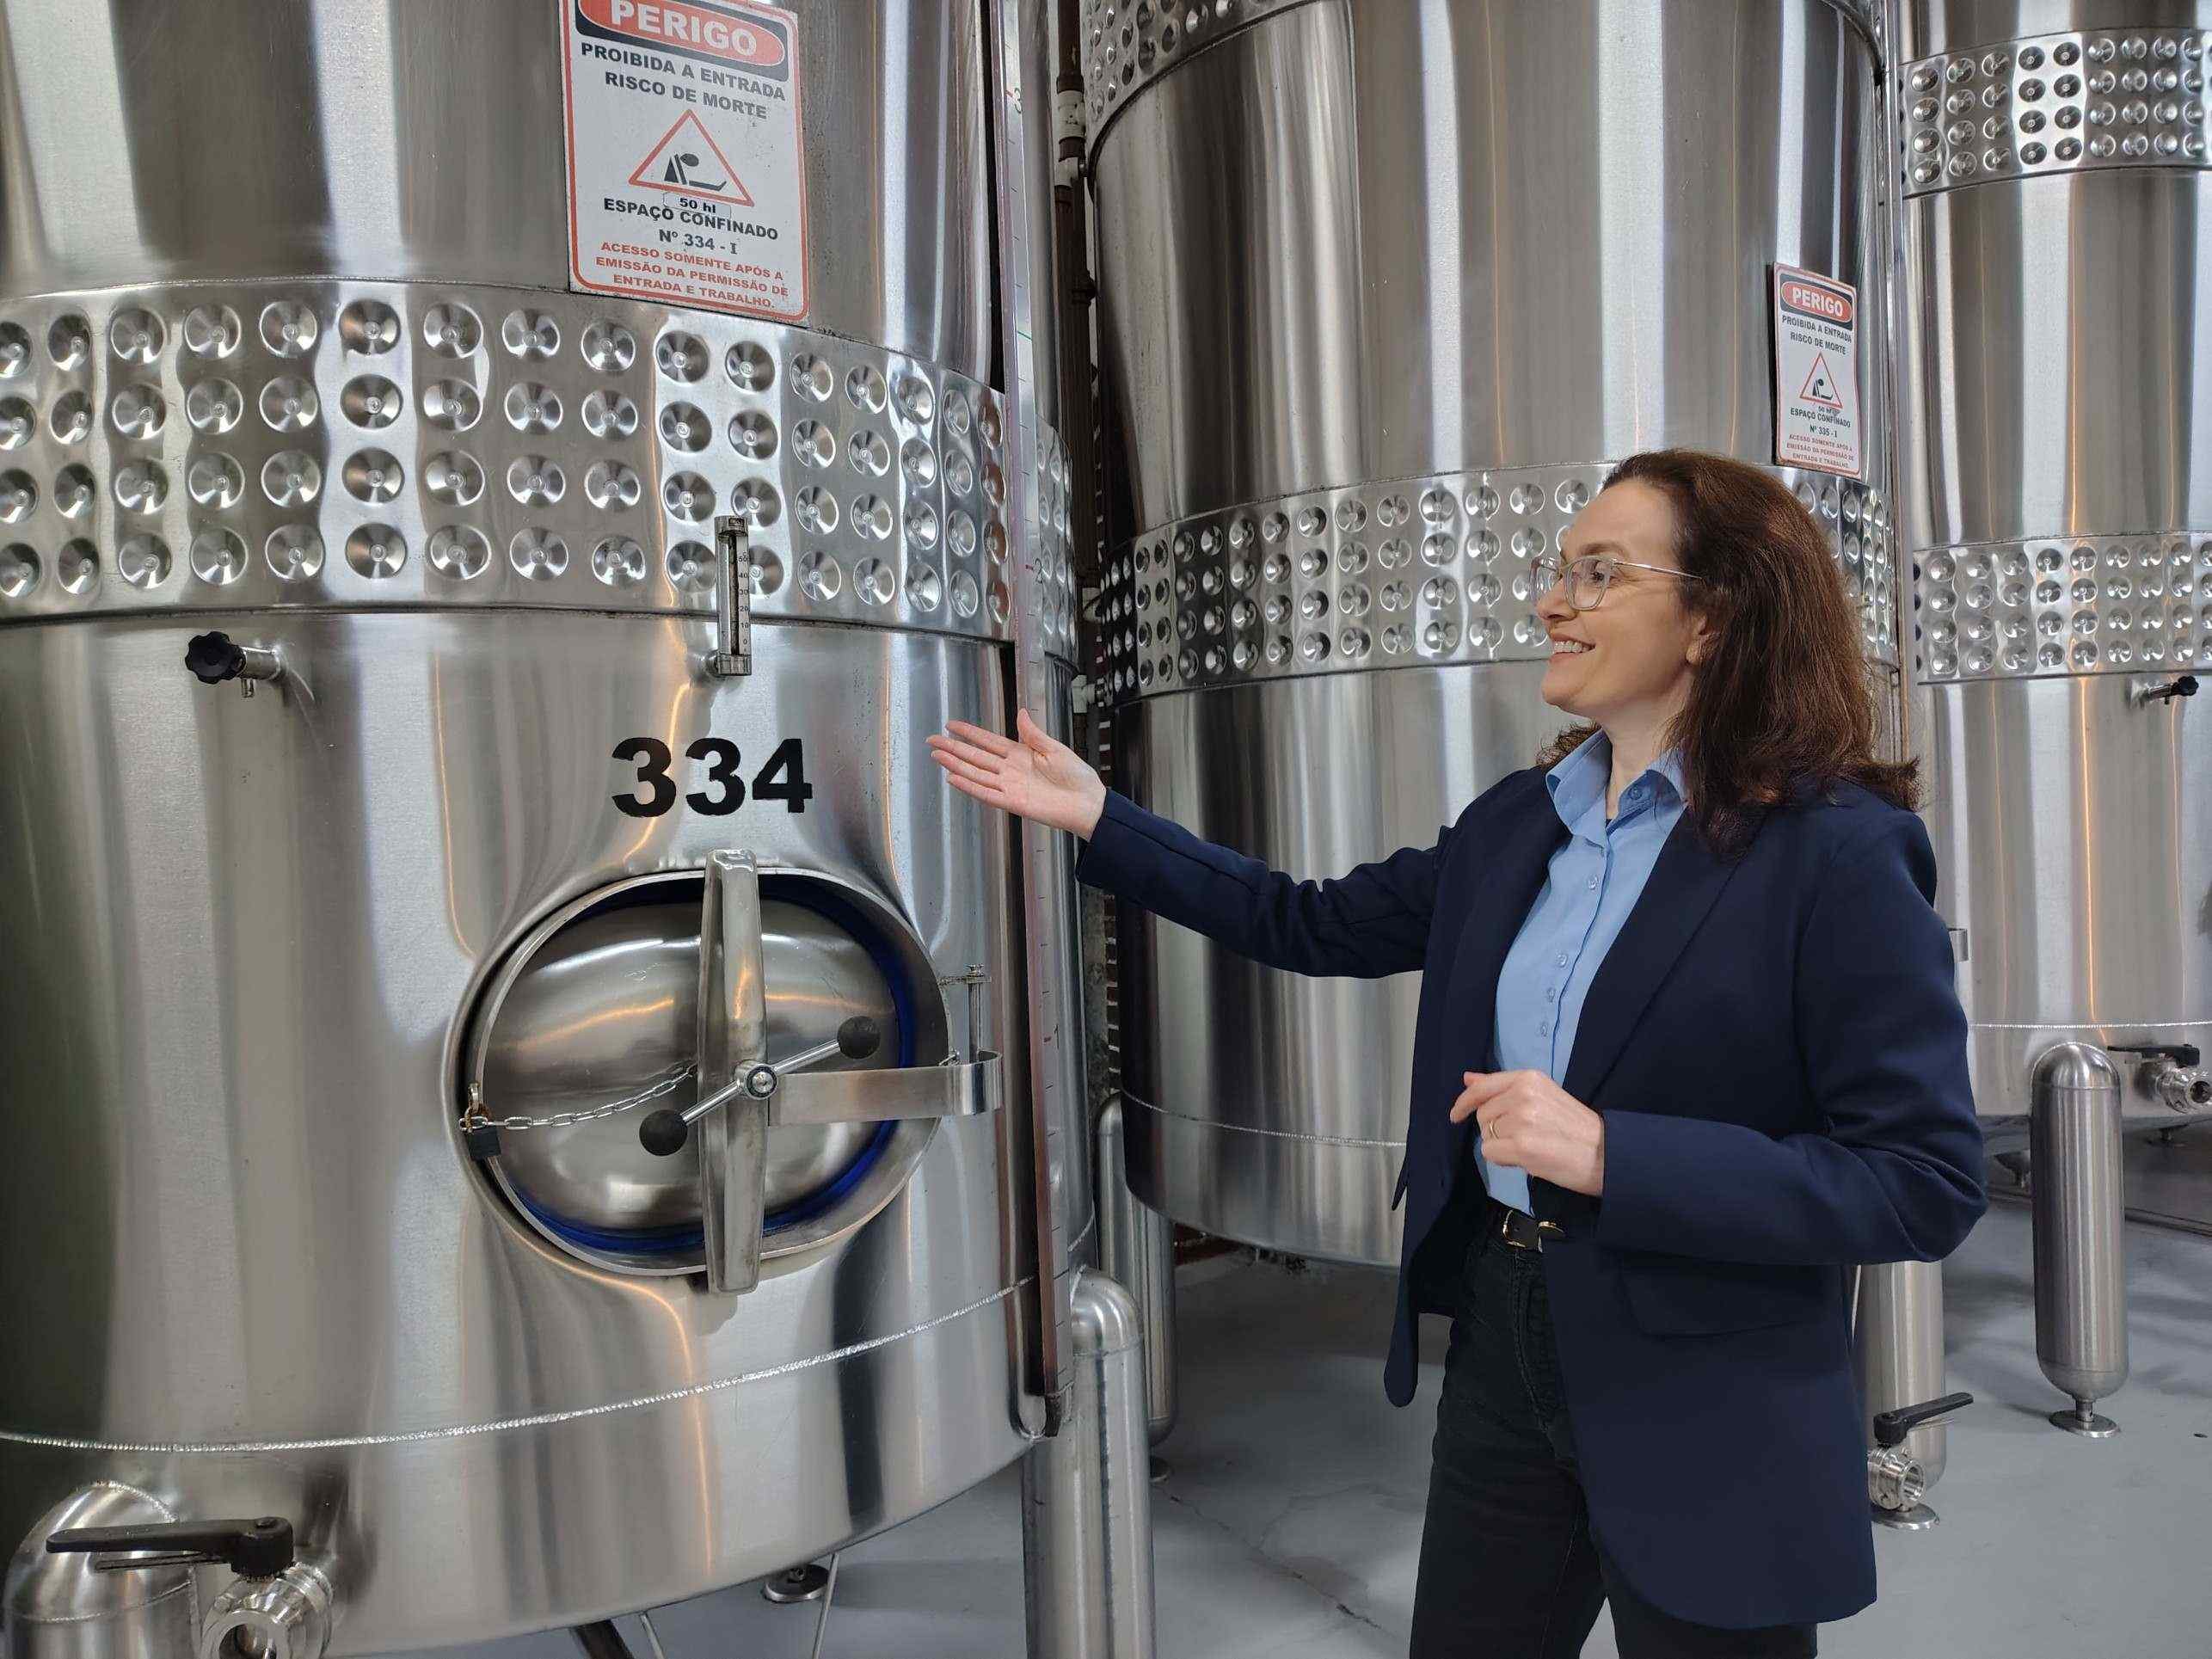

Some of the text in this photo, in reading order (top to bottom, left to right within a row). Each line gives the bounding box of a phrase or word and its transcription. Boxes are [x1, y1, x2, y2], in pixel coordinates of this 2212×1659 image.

[611, 0, 757, 57] PERIGO
[581, 43, 785, 101] PROIBIDA A ENTRADA
[605, 72, 767, 120] RISCO DE MORTE
[604, 198, 778, 240] ESPAÇO CONFINADO
[679, 198, 697, 209] 50
[685, 233, 714, 250] 334
[596, 256, 789, 297] EMISSÃO DA PERMISSÃO DE
[601, 242, 783, 280] ACESSO SOMENTE APÓS A
[613, 274, 681, 292] ENTRADA
[699, 288, 775, 308] TRABALHO.
[1792, 287, 1843, 316] PERIGO
[1782, 316, 1816, 330] PROIBIDA
[1824, 327, 1852, 343] ENTRADA
[1791, 332, 1846, 354] RISCO DE MORTE
[1791, 408, 1851, 427] ESPAÇO CONFINADO
[1035, 558, 1042, 584] 2
[611, 737, 813, 817] 334
[1054, 1023, 1060, 1049] 1
